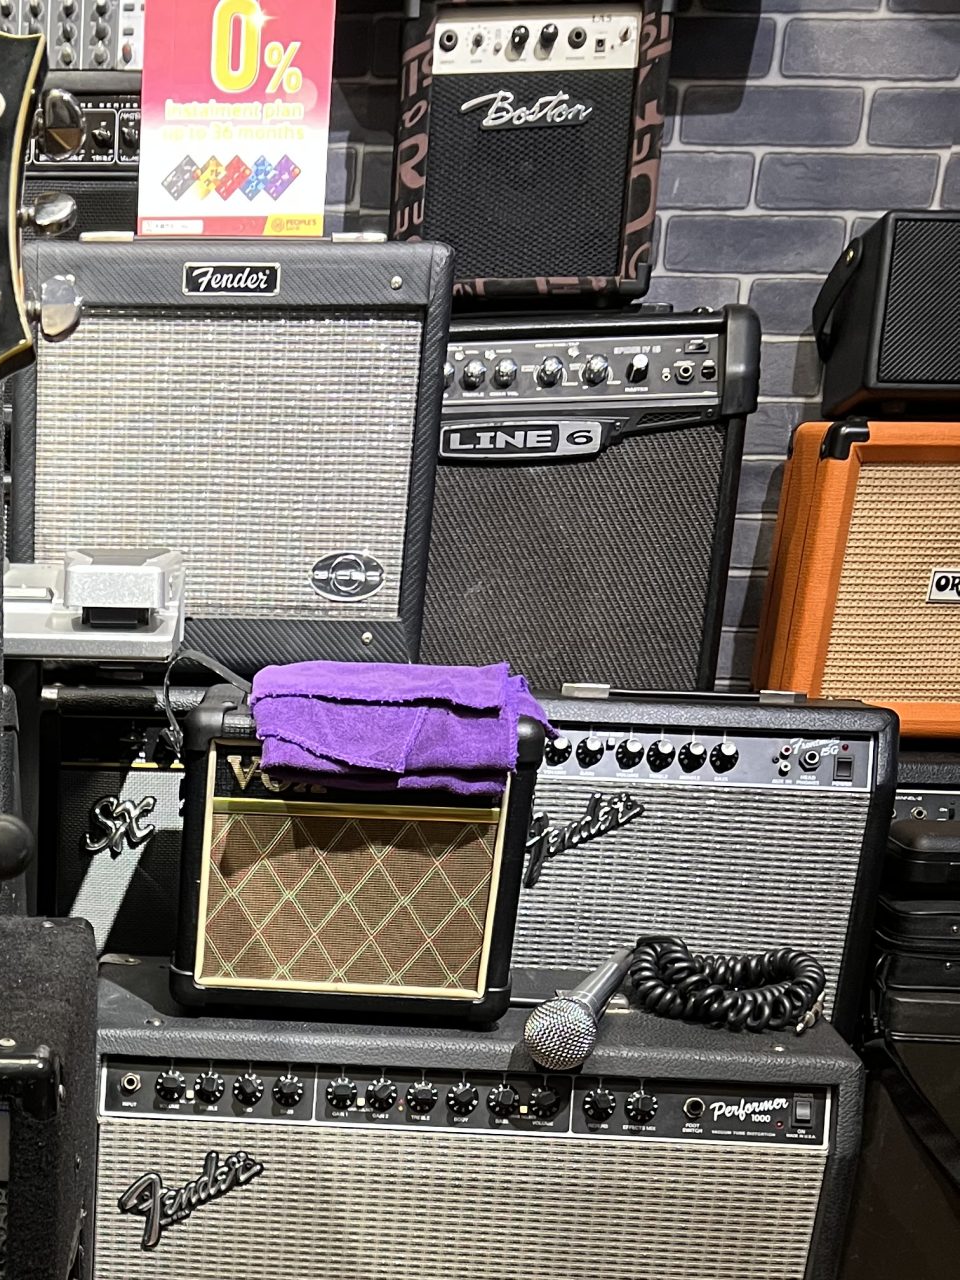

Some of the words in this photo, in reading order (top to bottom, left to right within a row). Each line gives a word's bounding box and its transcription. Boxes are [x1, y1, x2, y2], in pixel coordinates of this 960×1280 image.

[210, 0, 303, 93] 0%
[460, 90, 592, 127] Boston
[238, 123, 305, 140] months
[192, 267, 269, 292] Fender
[449, 430, 552, 450] LINE
[566, 429, 593, 445] 6
[522, 791, 644, 889] Fender
[709, 1097, 789, 1122] Performer
[751, 1113, 771, 1122] 1000
[118, 1150, 264, 1250] Fender
